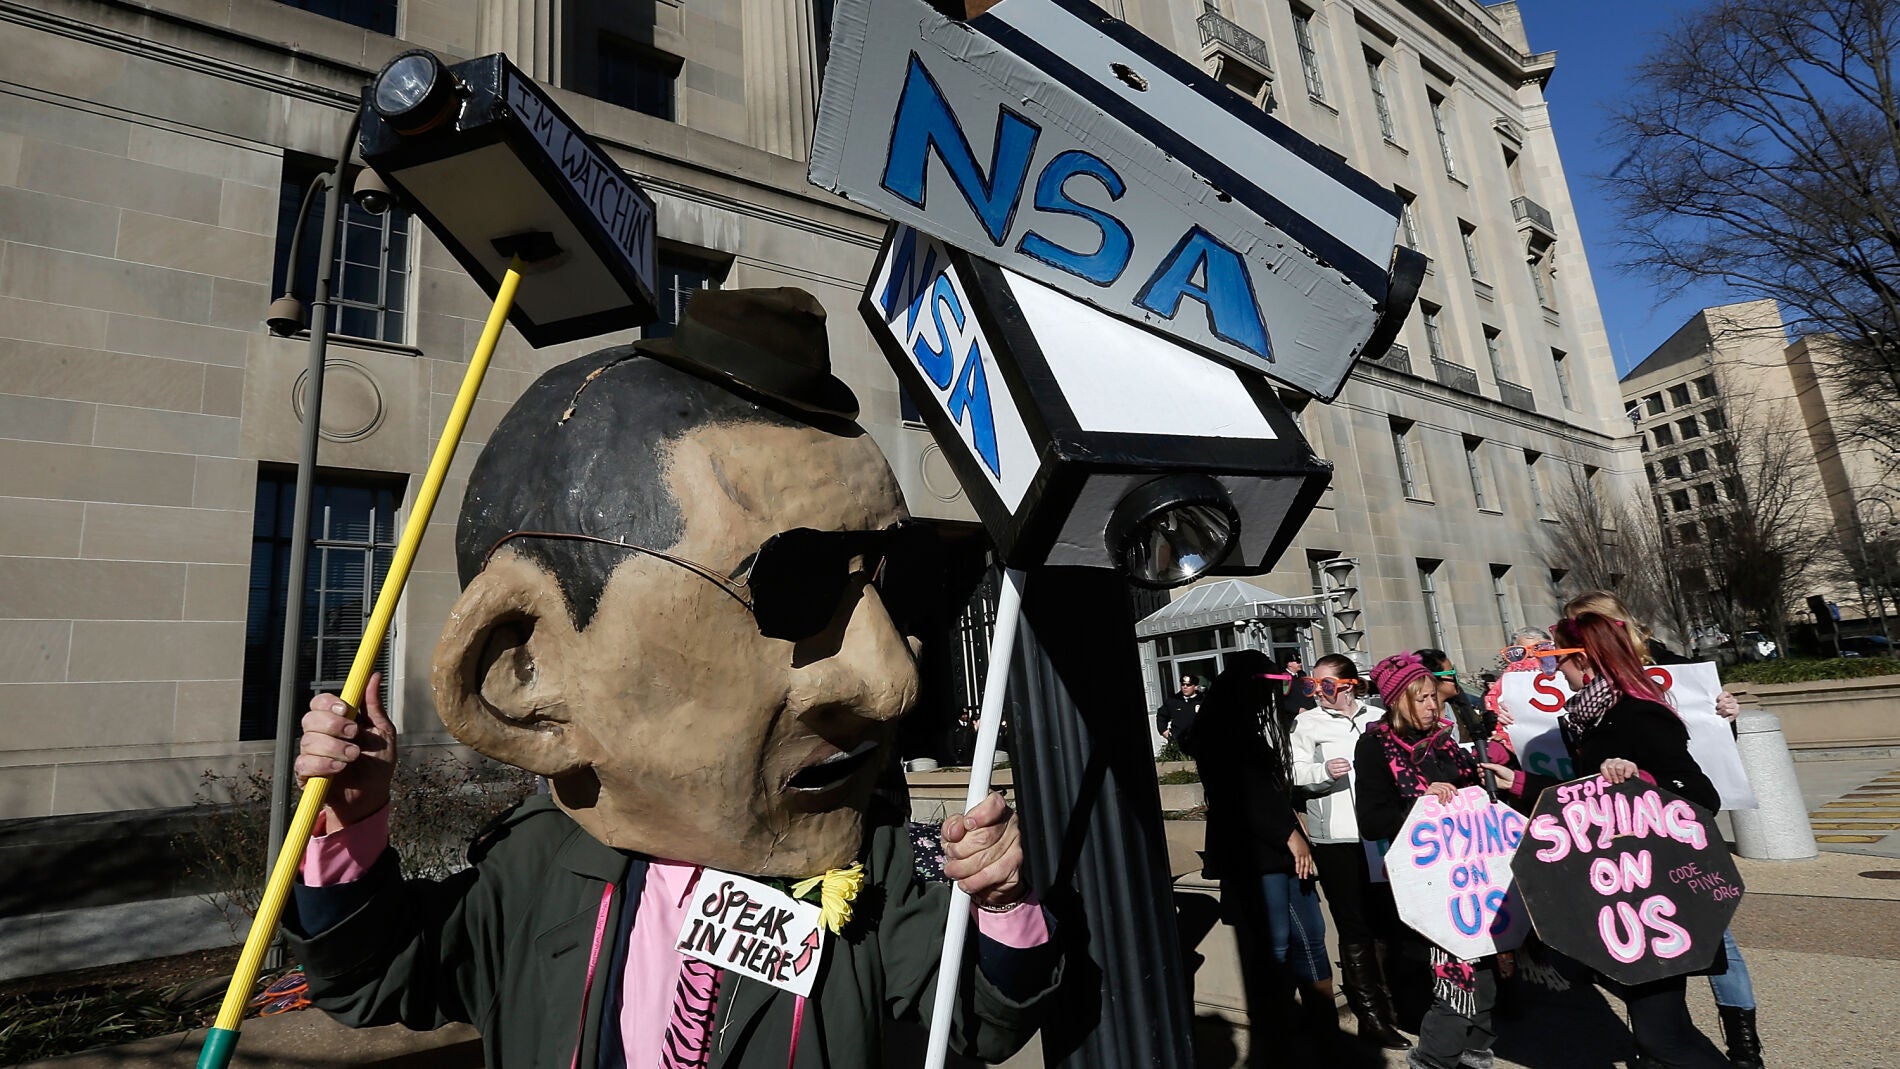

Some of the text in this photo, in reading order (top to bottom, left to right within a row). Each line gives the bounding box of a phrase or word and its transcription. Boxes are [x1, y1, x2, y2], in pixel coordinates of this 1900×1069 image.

[515, 83, 651, 273] I'M WATCHIN
[881, 49, 1276, 364] NSA
[880, 226, 1001, 484] NSA
[1408, 802, 1528, 869] SPYING
[1529, 790, 1708, 863] SPYING
[1449, 857, 1492, 892] ON
[1590, 850, 1652, 895] ON
[1668, 862, 1702, 884] CODE
[1687, 871, 1726, 895] PINK
[701, 880, 795, 946] SPEAK
[1448, 885, 1511, 939] US
[1598, 895, 1692, 963] US
[677, 918, 795, 983] IN HERE
